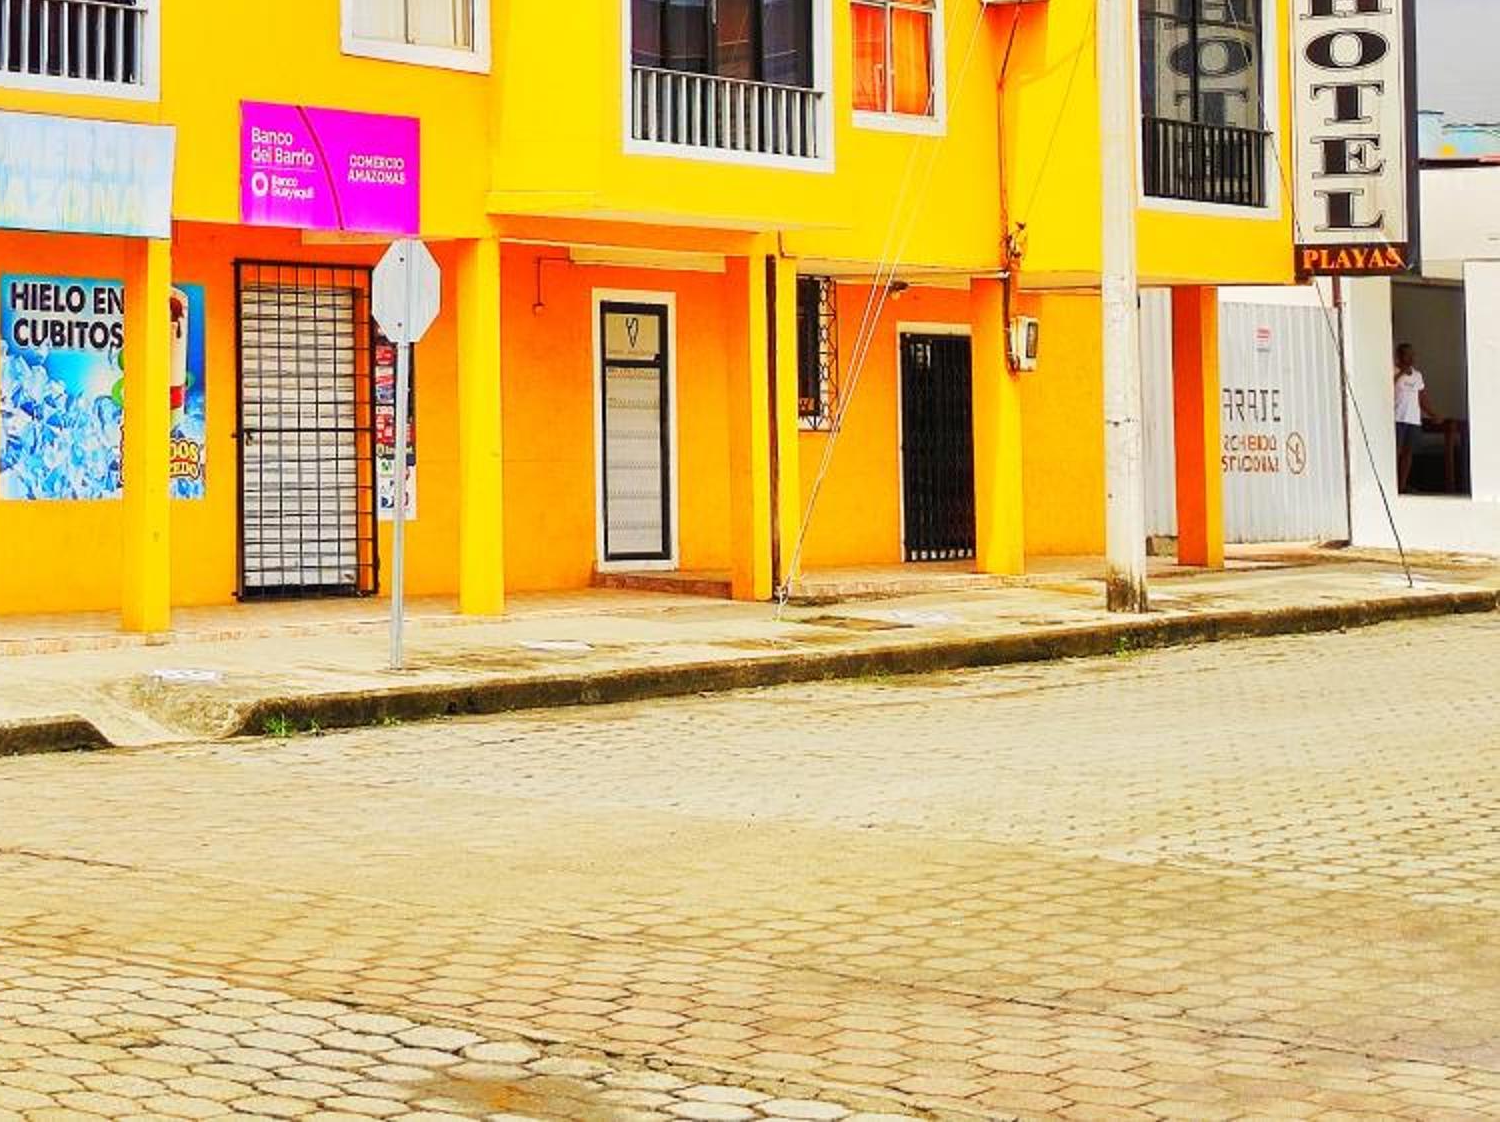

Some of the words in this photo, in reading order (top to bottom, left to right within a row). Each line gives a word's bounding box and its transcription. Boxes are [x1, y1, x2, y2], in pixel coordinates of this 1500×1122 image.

[251, 127, 293, 145] Banco
[251, 147, 272, 162] del
[276, 148, 314, 166] Barrio
[349, 154, 404, 170] COMERCIO
[348, 169, 405, 185] AMAZONAS
[1303, 247, 1405, 269] PLAYAS
[11, 282, 86, 314] HIELO
[93, 287, 124, 315] EN
[13, 317, 124, 349] CUBITOS
[1222, 387, 1281, 423] ARAJE
